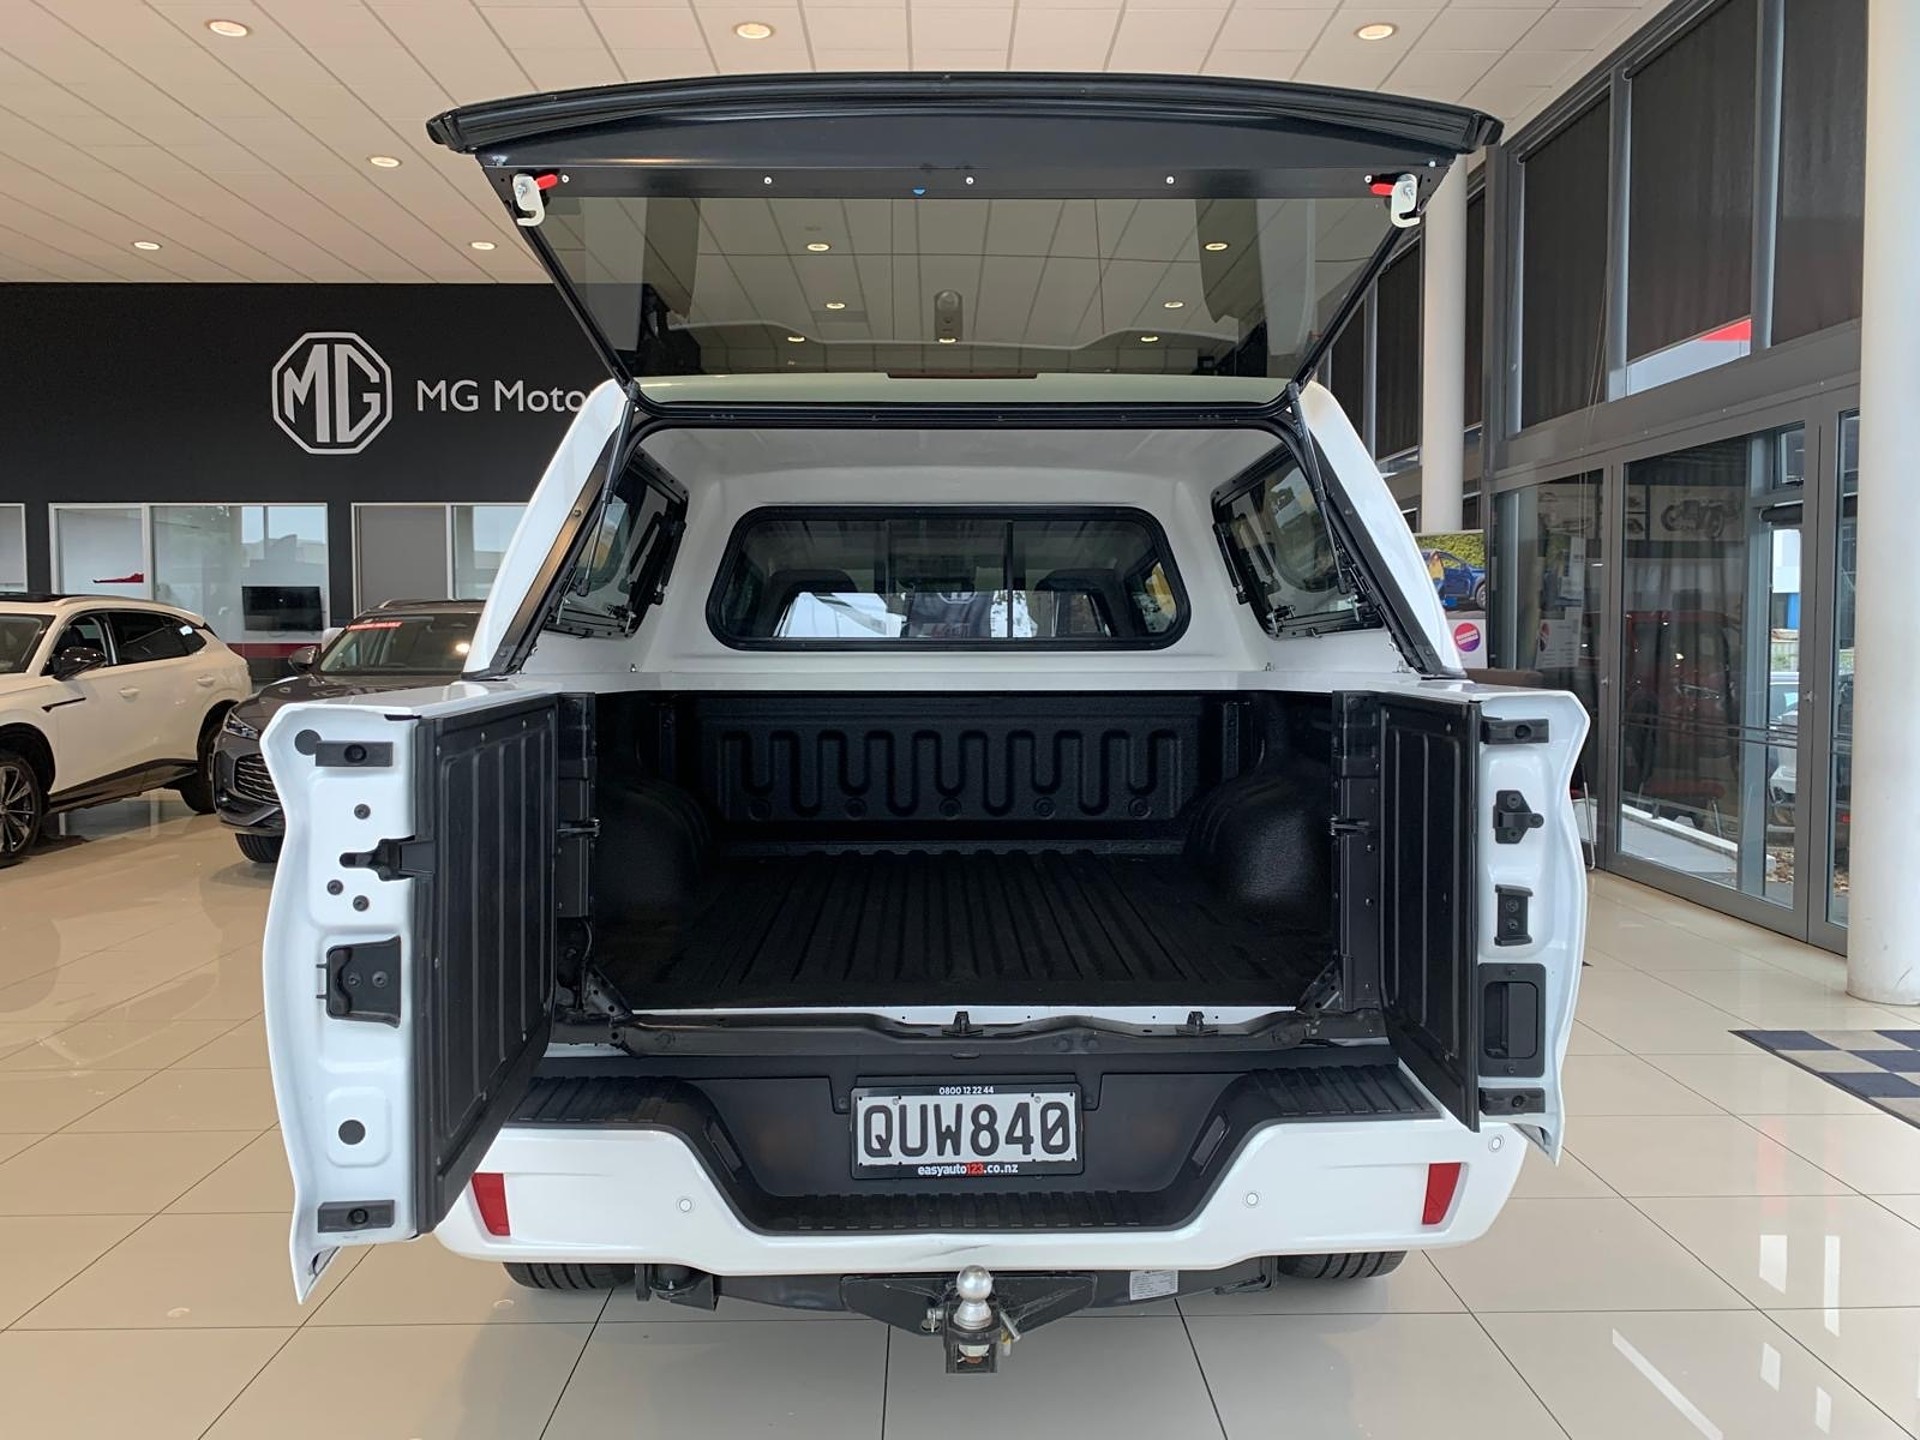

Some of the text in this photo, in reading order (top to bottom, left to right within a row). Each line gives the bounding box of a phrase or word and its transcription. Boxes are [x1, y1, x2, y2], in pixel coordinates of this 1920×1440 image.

[283, 343, 381, 443] MG
[416, 379, 479, 412] MG
[939, 1086, 962, 1095] 0800
[863, 1101, 1071, 1158] QUW840
[917, 1163, 1019, 1176] easyauto123.co.nz
